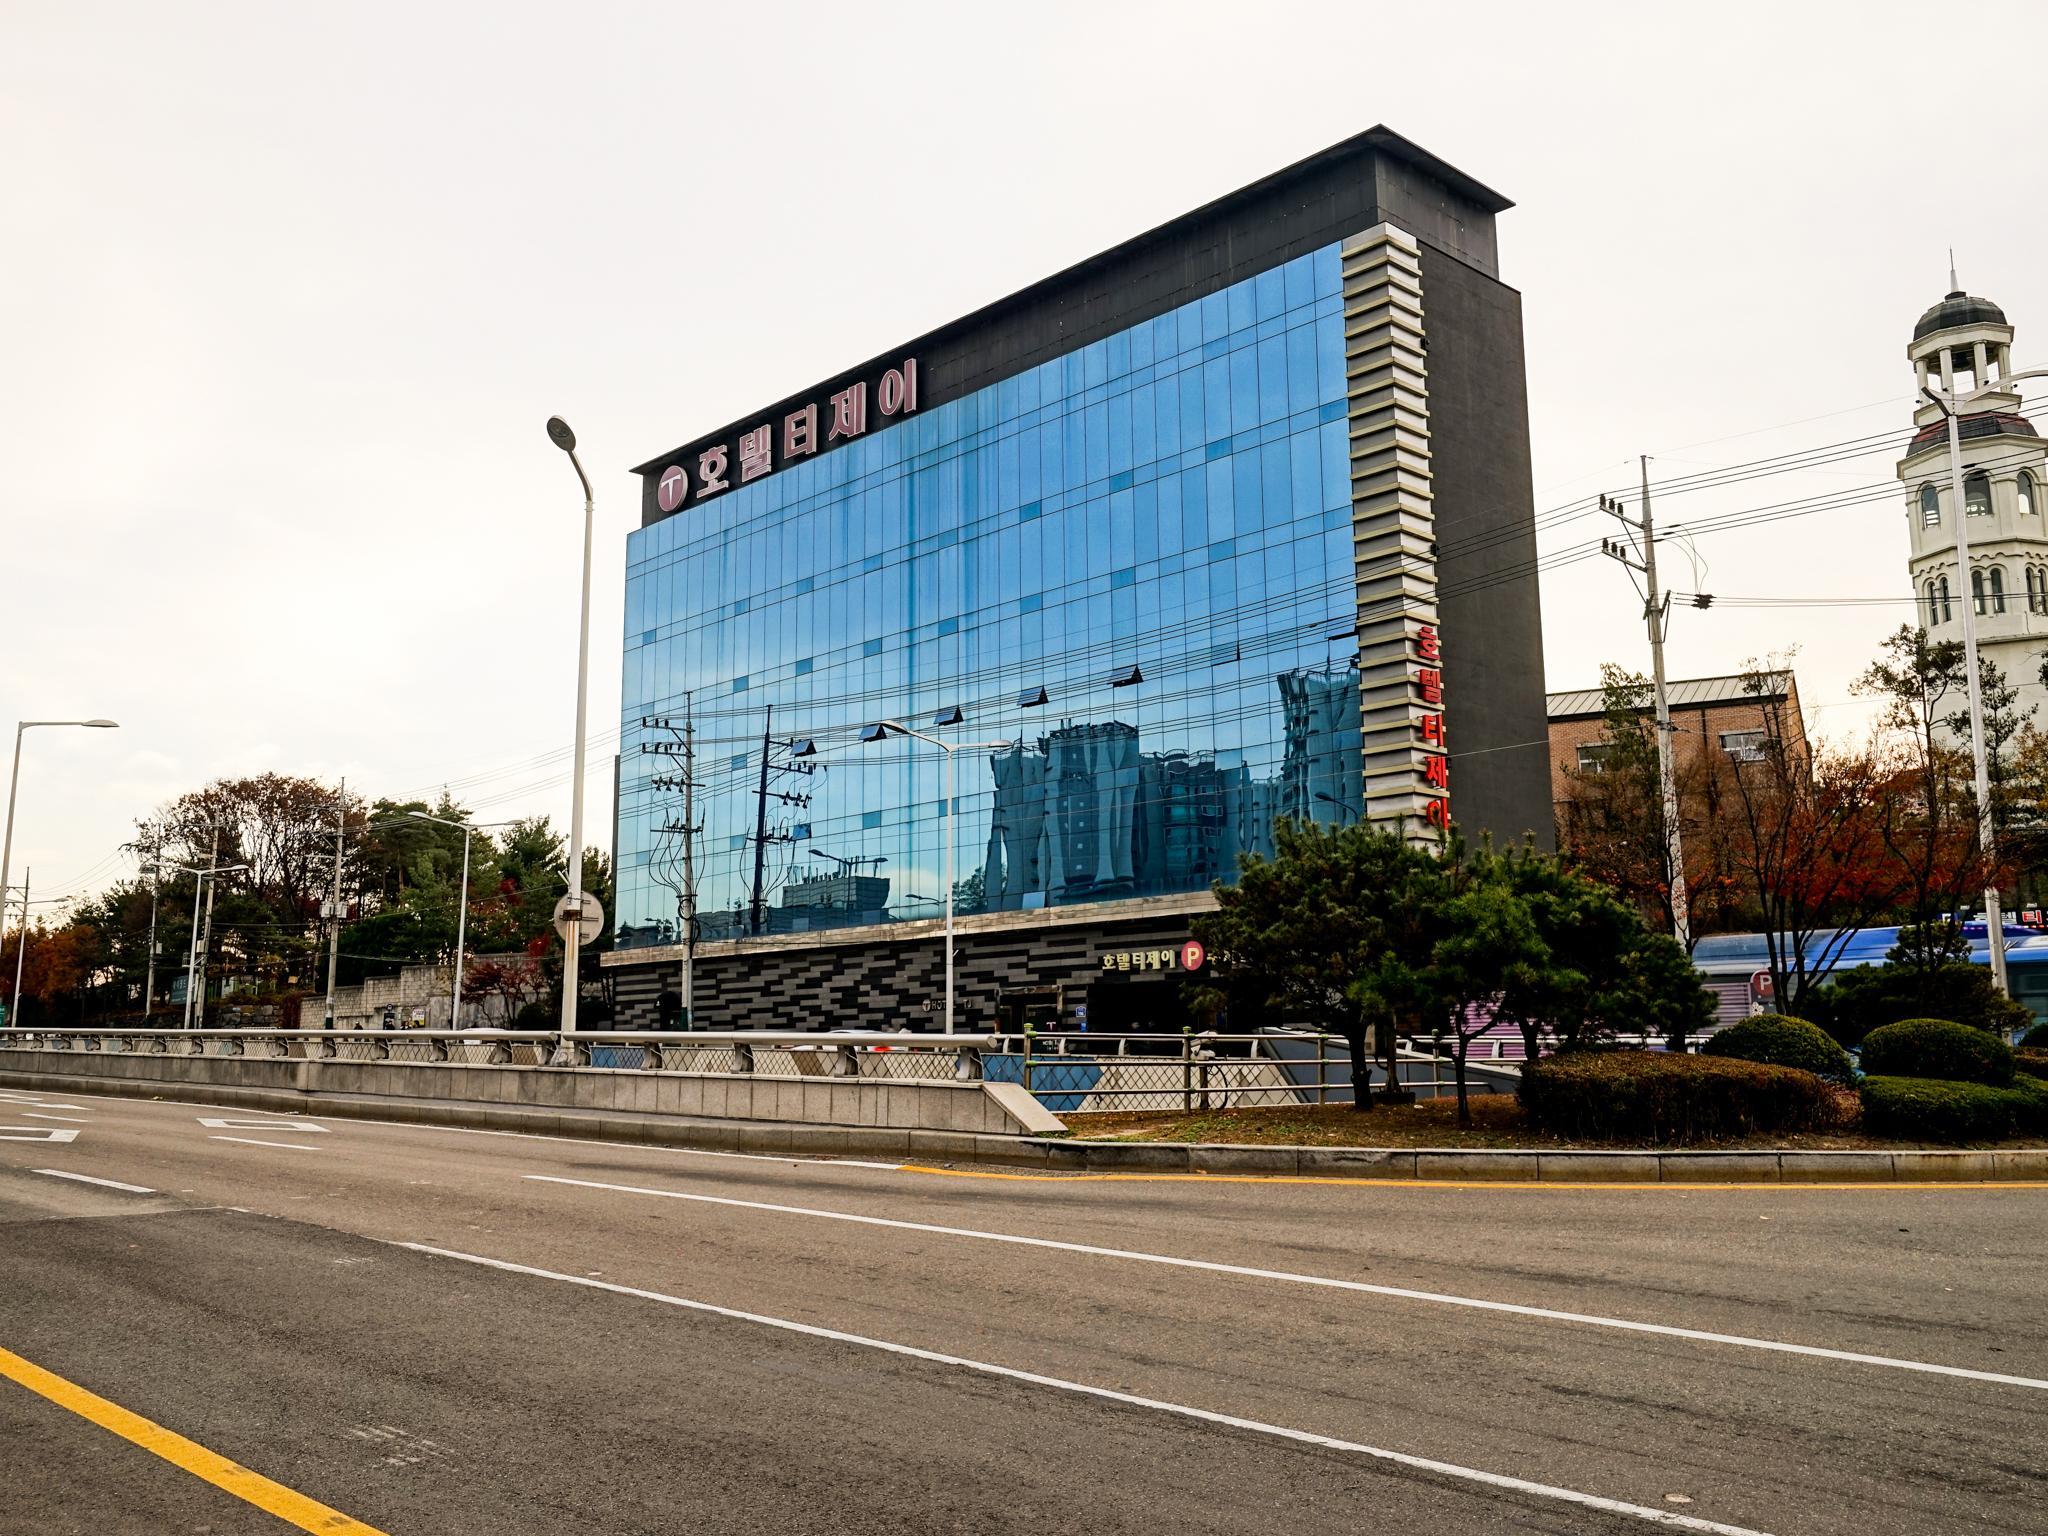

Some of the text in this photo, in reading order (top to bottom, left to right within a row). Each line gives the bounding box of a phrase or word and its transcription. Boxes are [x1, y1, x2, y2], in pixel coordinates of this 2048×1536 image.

[696, 357, 917, 499] 호텔티제이
[1417, 626, 1449, 830] 호텔티제이
[1102, 949, 1176, 971] 호텔티제이
[1187, 947, 1200, 967] P
[1760, 974, 1773, 990] P
[931, 1000, 957, 1010] HOT
